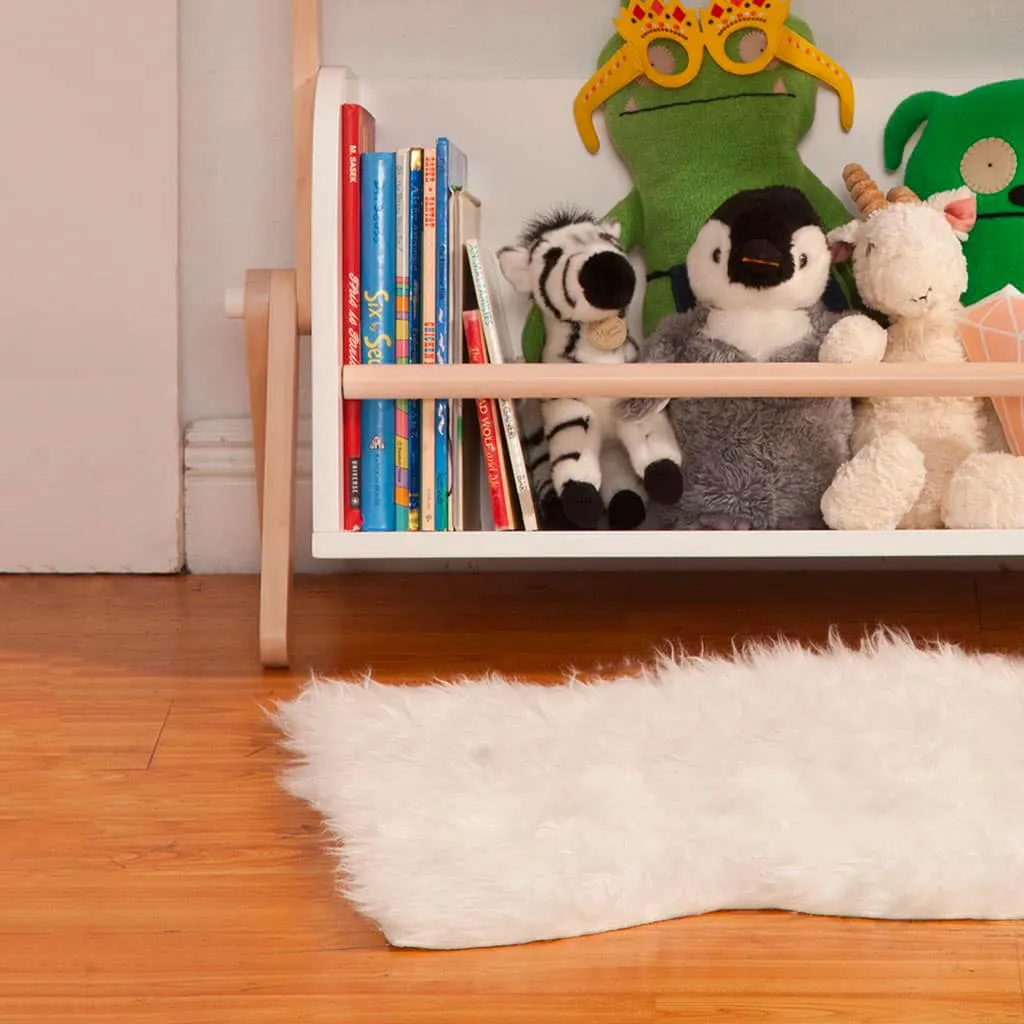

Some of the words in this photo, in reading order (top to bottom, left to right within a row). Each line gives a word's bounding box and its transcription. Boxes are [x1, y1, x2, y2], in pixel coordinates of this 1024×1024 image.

[349, 156, 357, 183] SASEK
[363, 289, 390, 319] Six
[482, 417, 496, 450] WOLF
[486, 452, 498, 472] and
